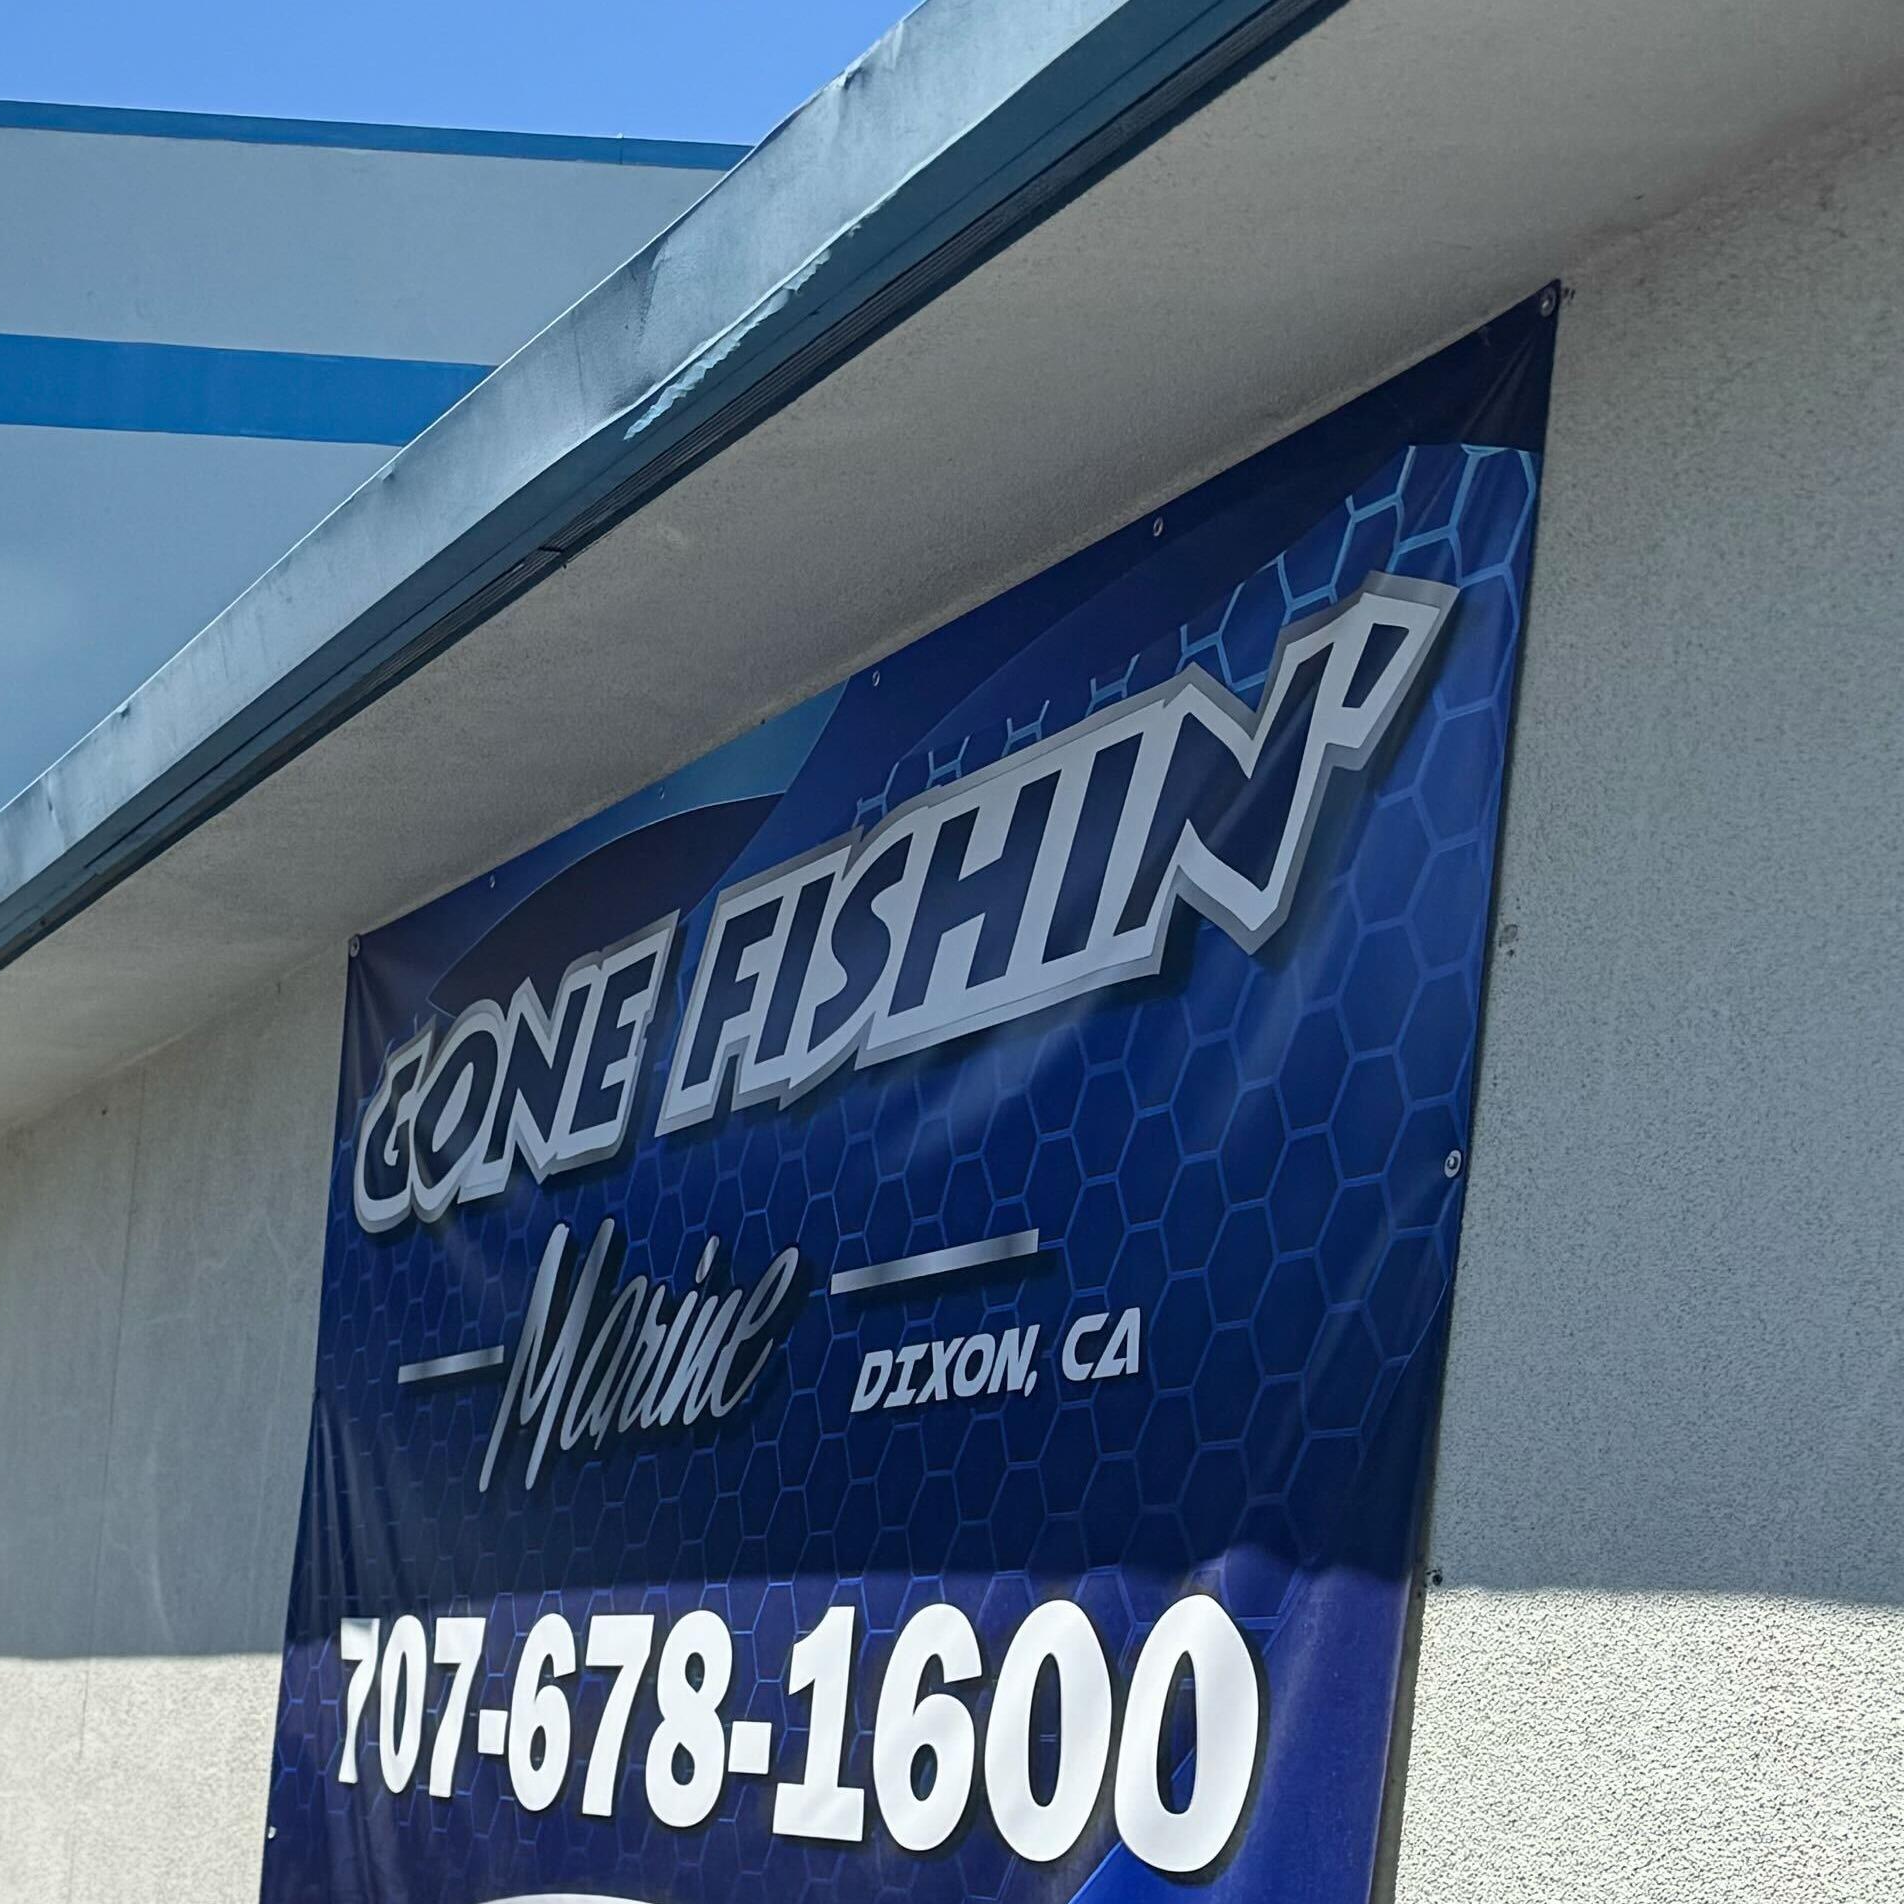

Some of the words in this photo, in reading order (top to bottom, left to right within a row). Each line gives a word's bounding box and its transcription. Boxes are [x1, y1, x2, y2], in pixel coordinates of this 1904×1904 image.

[355, 909, 680, 1232] GONE
[658, 574, 1456, 1136] FISHIN'
[479, 1217, 801, 1493] Marine
[851, 1324, 1039, 1414] DIXON,
[1061, 1305, 1142, 1382] CA
[338, 1593, 1258, 1874] 707-678-1600
